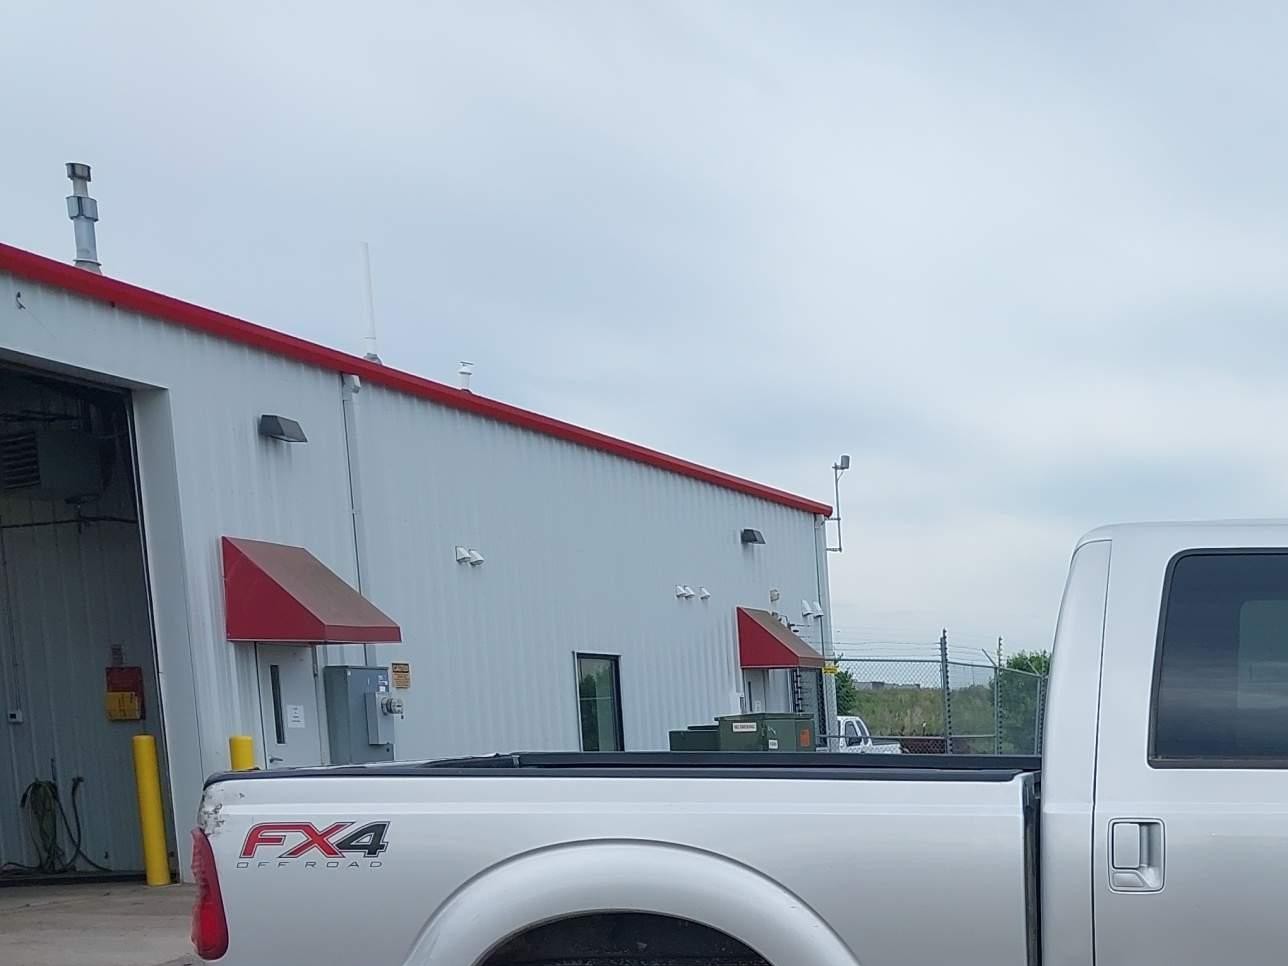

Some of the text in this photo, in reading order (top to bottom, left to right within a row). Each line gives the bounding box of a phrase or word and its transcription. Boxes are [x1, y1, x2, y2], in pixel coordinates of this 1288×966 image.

[239, 821, 391, 858] FX4
[236, 861, 383, 869] OFF ROAD
